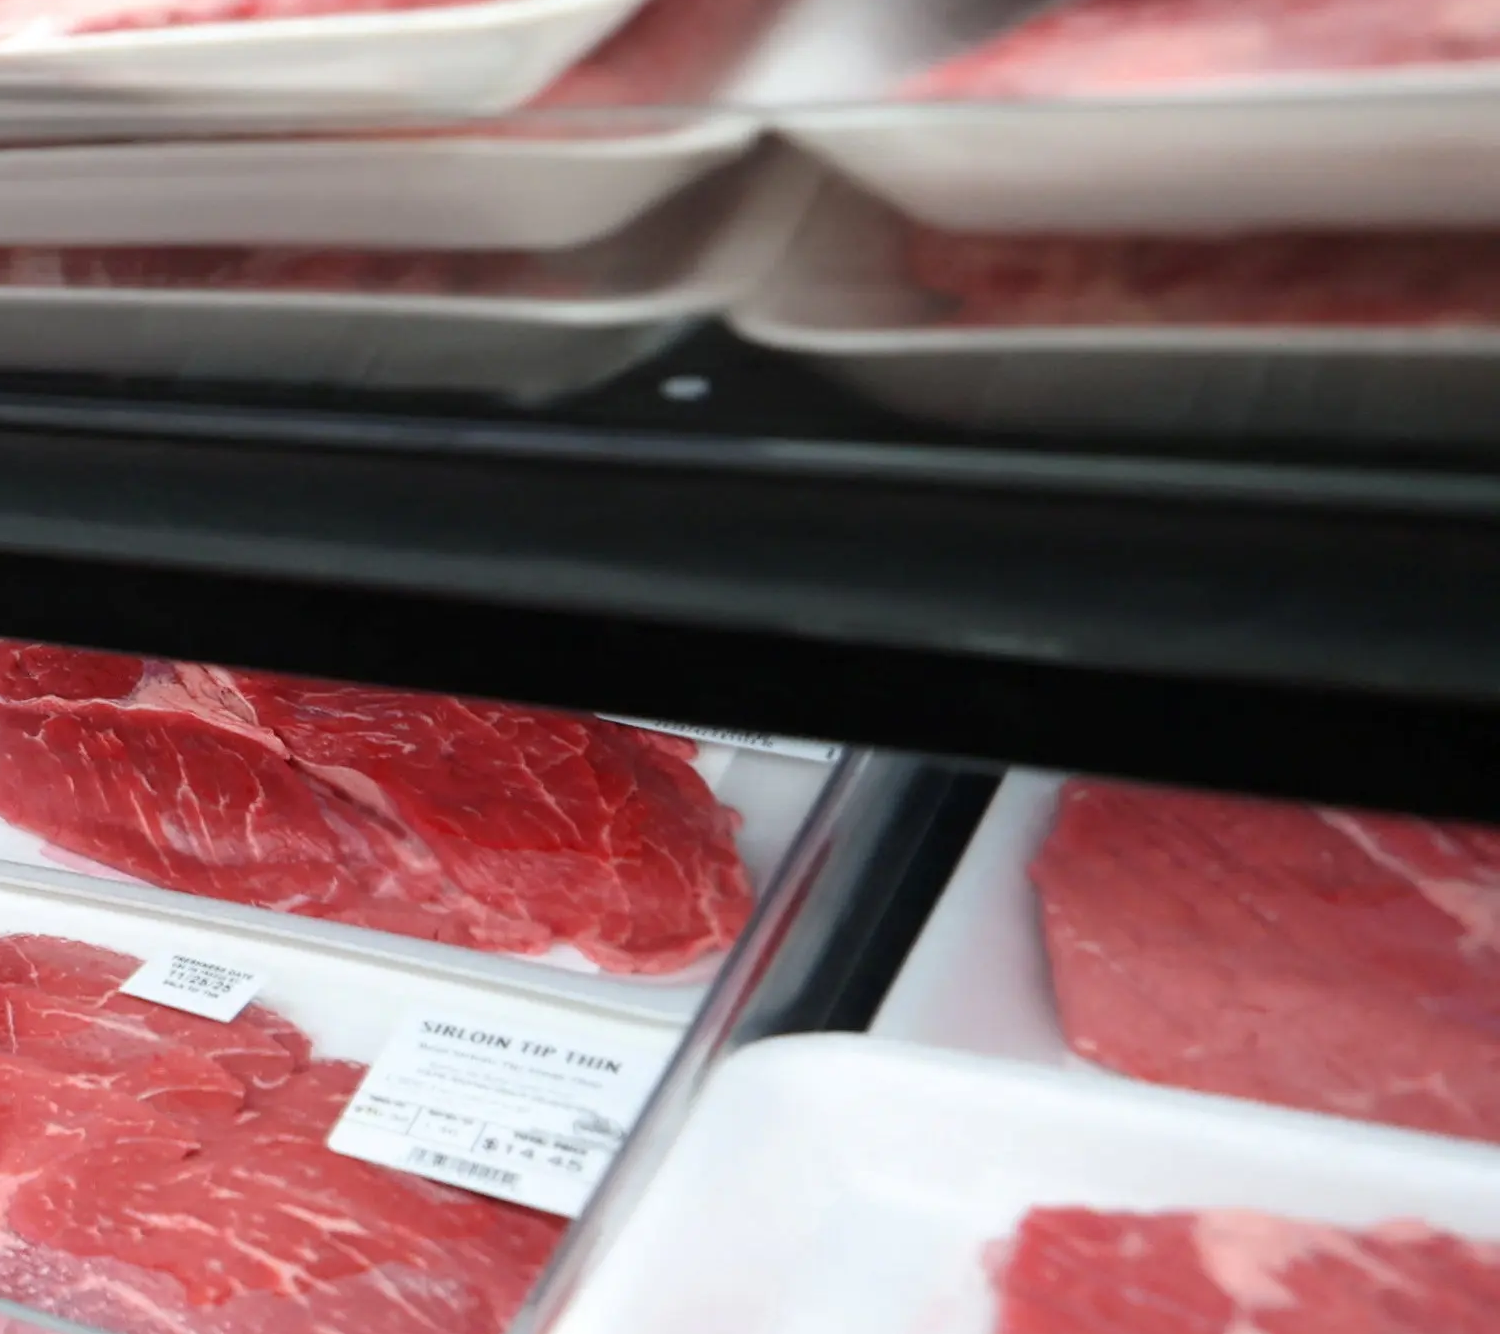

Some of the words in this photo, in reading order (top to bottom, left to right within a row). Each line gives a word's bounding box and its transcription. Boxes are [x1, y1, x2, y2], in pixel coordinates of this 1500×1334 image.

[420, 1020, 513, 1050] SIRLOIN
[520, 1039, 558, 1058] TIP
[564, 1051, 623, 1075] THIN
